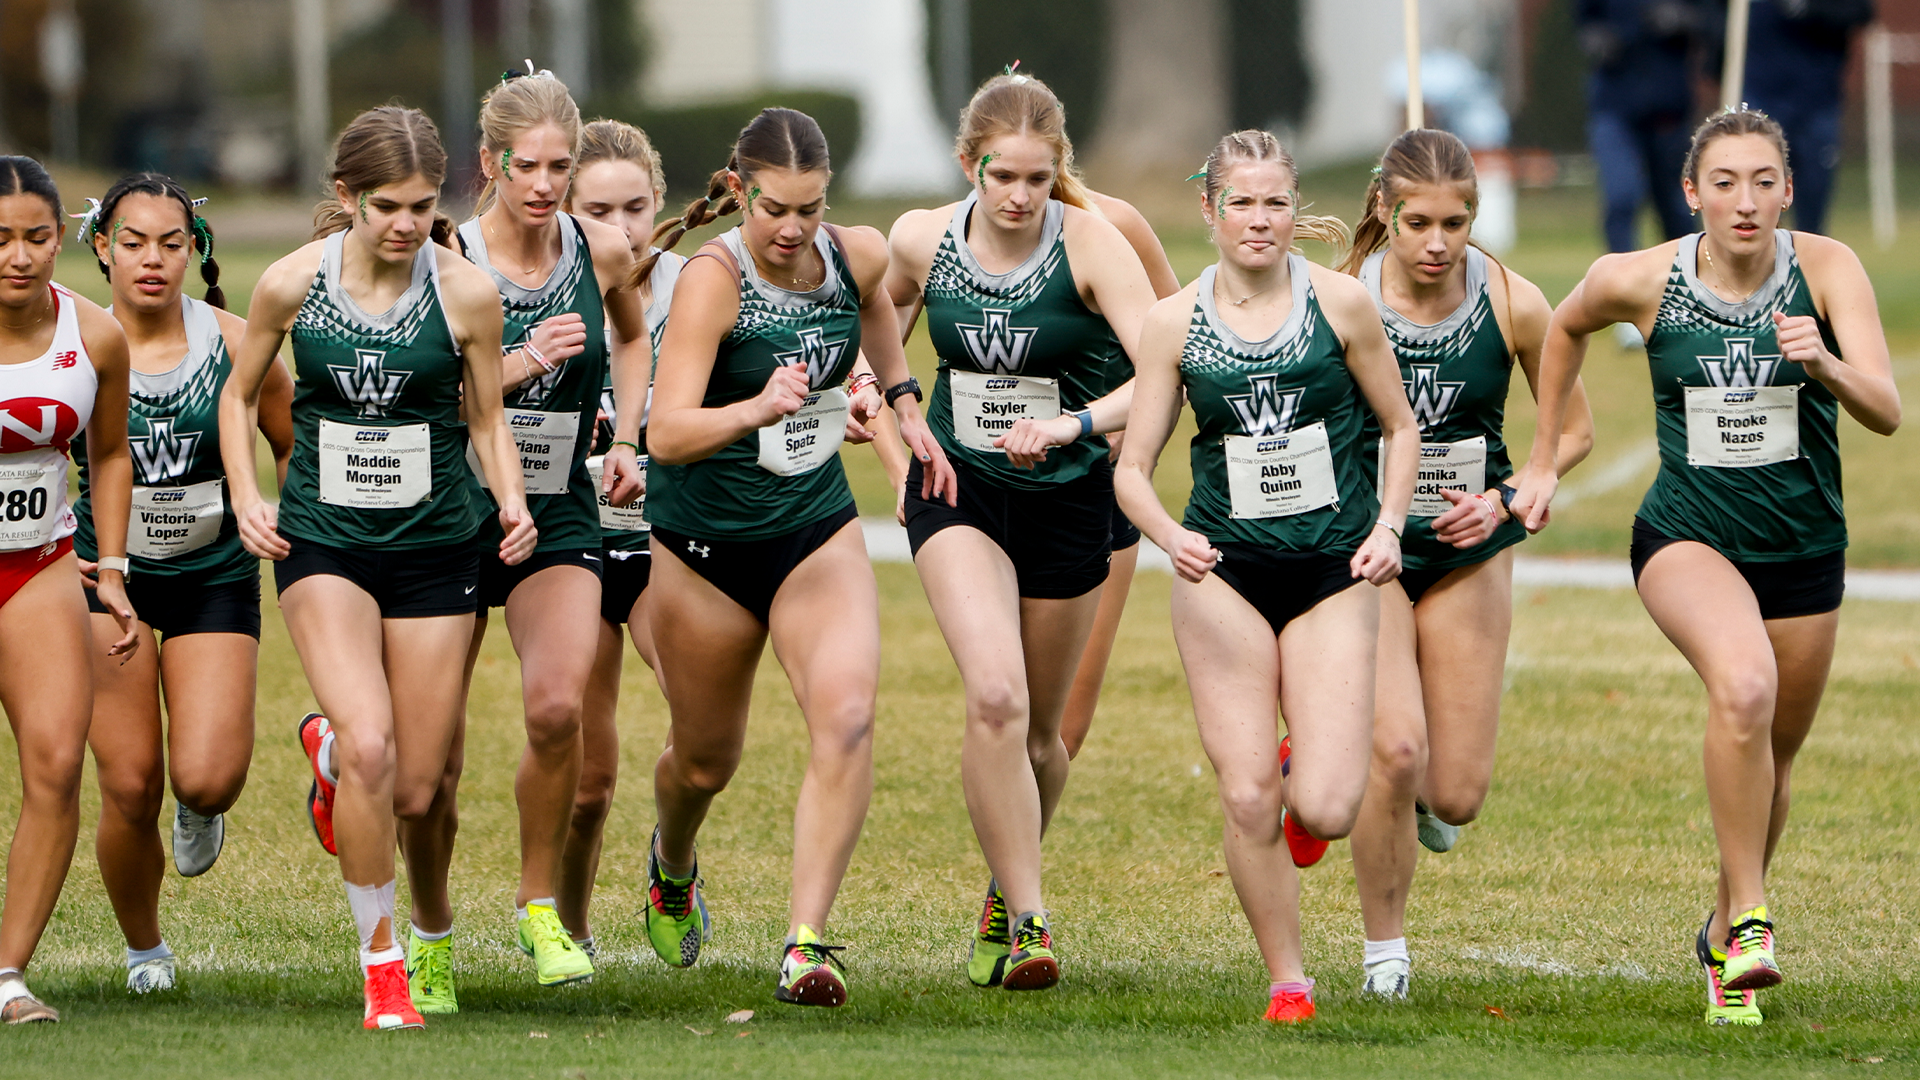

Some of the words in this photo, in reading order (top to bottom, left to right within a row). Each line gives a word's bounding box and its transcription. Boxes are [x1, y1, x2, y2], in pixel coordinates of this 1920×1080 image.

[986, 380, 1020, 389] CCIW
[982, 402, 1027, 416] Skyler
[0, 405, 59, 448] N
[510, 415, 546, 427] CCIW
[784, 418, 819, 435] Alexia
[1717, 415, 1767, 428] Brooke
[355, 431, 390, 441] CCIW
[1721, 431, 1764, 444] Nazos
[786, 434, 815, 453] Spatz
[1257, 439, 1290, 452] CCIW
[1290, 445, 1325, 460] Championships
[347, 454, 400, 468] Maddie
[1446, 459, 1482, 467] Championships
[1261, 464, 1296, 478] Abby
[346, 470, 401, 487] Morgan
[1260, 479, 1301, 495] Quinn
[152, 492, 187, 501] CCIW
[183, 501, 218, 511] Championships
[141, 512, 196, 524] Victoria
[12, 530, 40, 538] RESULTS
[147, 527, 189, 540] Lopez
